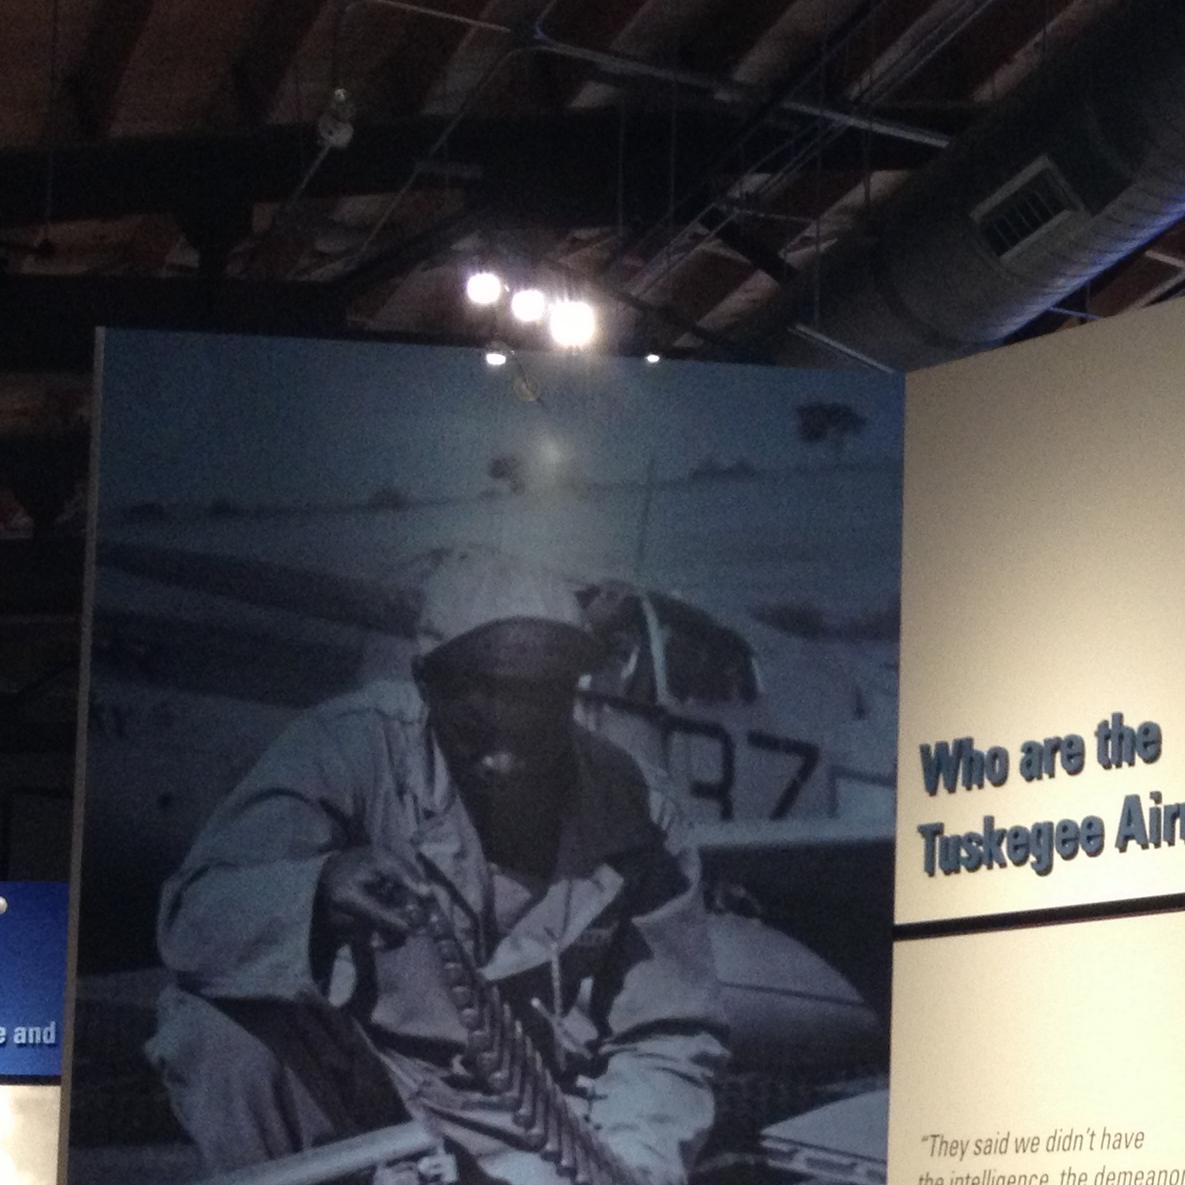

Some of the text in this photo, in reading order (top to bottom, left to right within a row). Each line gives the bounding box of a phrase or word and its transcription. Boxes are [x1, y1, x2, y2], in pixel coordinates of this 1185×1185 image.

[920, 713, 1162, 796] Who are the
[917, 815, 1104, 877] Tuskegee
[14, 1021, 56, 1043] and
[973, 1131, 1010, 1156] said
[1014, 1135, 1040, 1153] we
[1100, 1126, 1144, 1150] have
